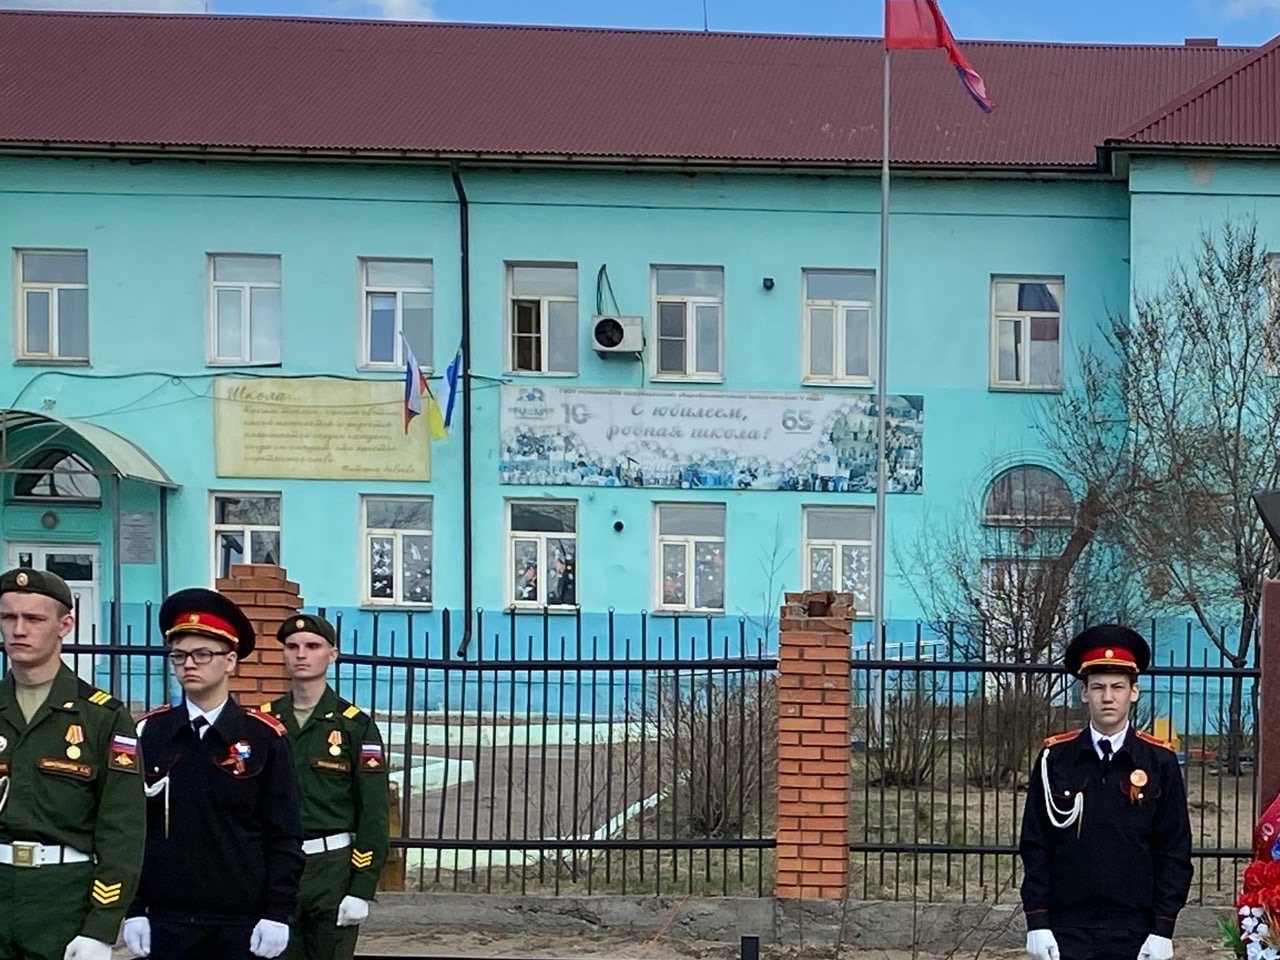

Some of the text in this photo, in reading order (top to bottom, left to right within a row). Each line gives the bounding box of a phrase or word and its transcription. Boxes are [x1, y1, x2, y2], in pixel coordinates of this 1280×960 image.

[630, 402, 748, 421] С юбилеем,
[606, 422, 772, 441] родная школа!
